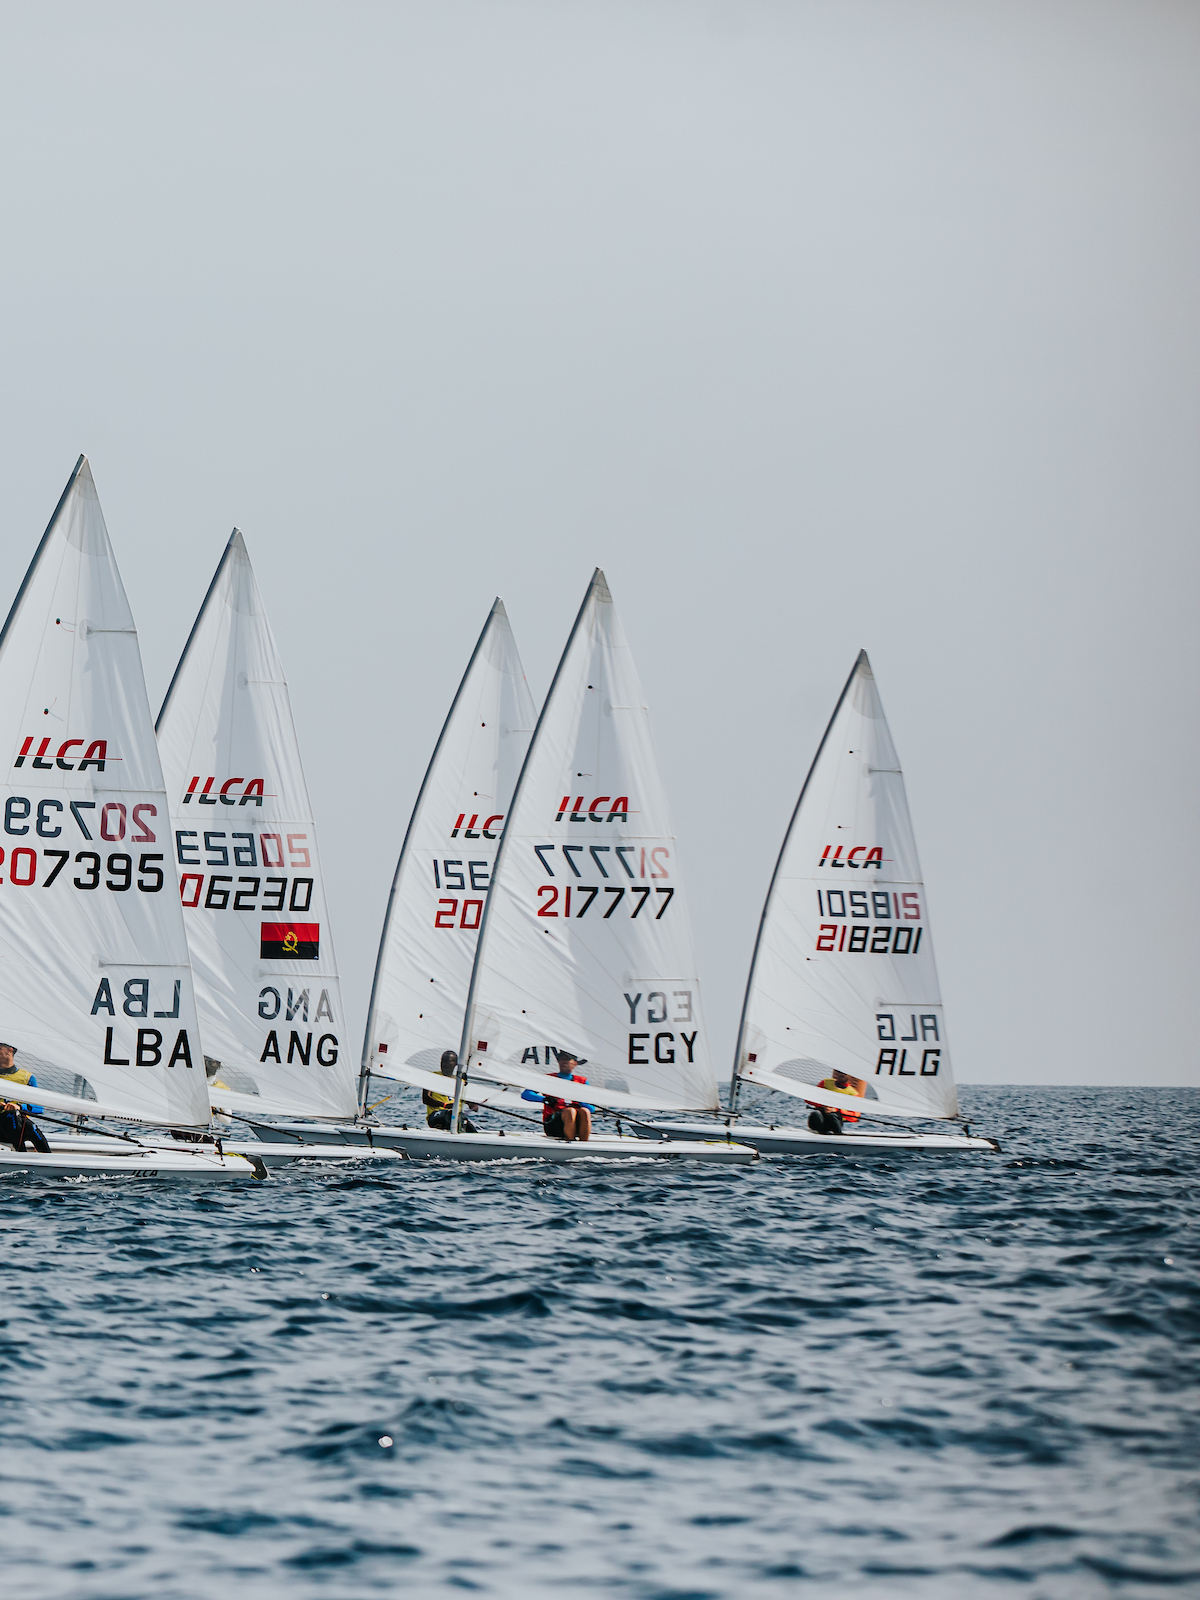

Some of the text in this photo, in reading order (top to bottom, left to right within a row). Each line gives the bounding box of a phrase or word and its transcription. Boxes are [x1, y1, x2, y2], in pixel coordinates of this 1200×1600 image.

[13, 736, 107, 772] ILCA
[182, 776, 265, 807] ILCA
[555, 796, 629, 823] ILCA
[450, 813, 505, 840] ILC
[818, 845, 883, 869] ILCA
[434, 898, 484, 929] 20
[537, 885, 674, 920] 217777
[816, 924, 923, 954] 218201
[103, 1026, 193, 1069] LBA
[259, 1029, 339, 1067] ANG
[628, 1030, 698, 1065] EGY
[875, 1048, 941, 1076] ALG
